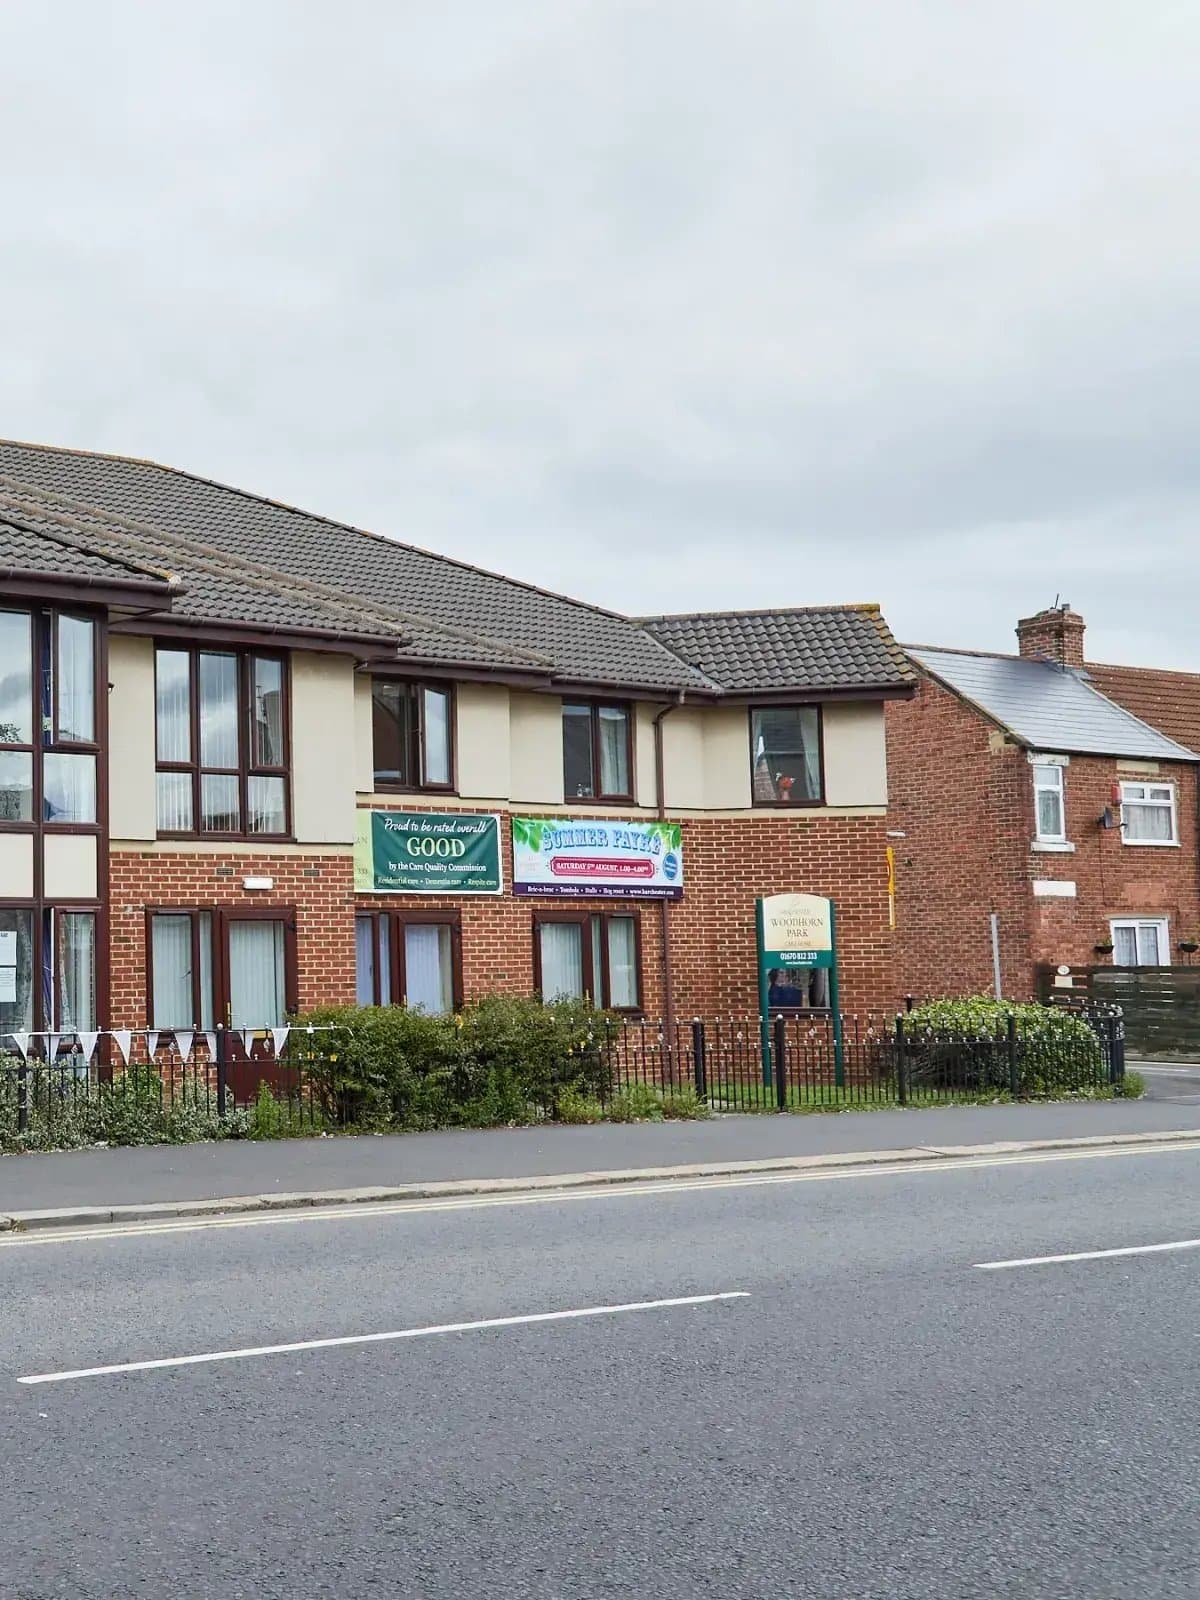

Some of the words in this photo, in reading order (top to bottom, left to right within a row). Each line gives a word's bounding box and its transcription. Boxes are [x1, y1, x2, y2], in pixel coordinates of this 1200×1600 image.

[384, 818, 410, 831] Proud
[411, 821, 419, 831] to
[421, 819, 432, 832] be
[433, 820, 457, 833] rated
[457, 820, 487, 833] overall
[406, 836, 466, 857] GOOD
[543, 828, 609, 851] SUMMER
[613, 829, 662, 855] FAYRE
[388, 861, 397, 872] by
[398, 861, 408, 871] the
[409, 862, 424, 871] Care
[424, 862, 448, 873] Quality
[448, 863, 487, 872] Commission
[556, 862, 587, 870] SATURDAY
[770, 917, 824, 928] WOODHORN
[786, 928, 809, 938] PARK
